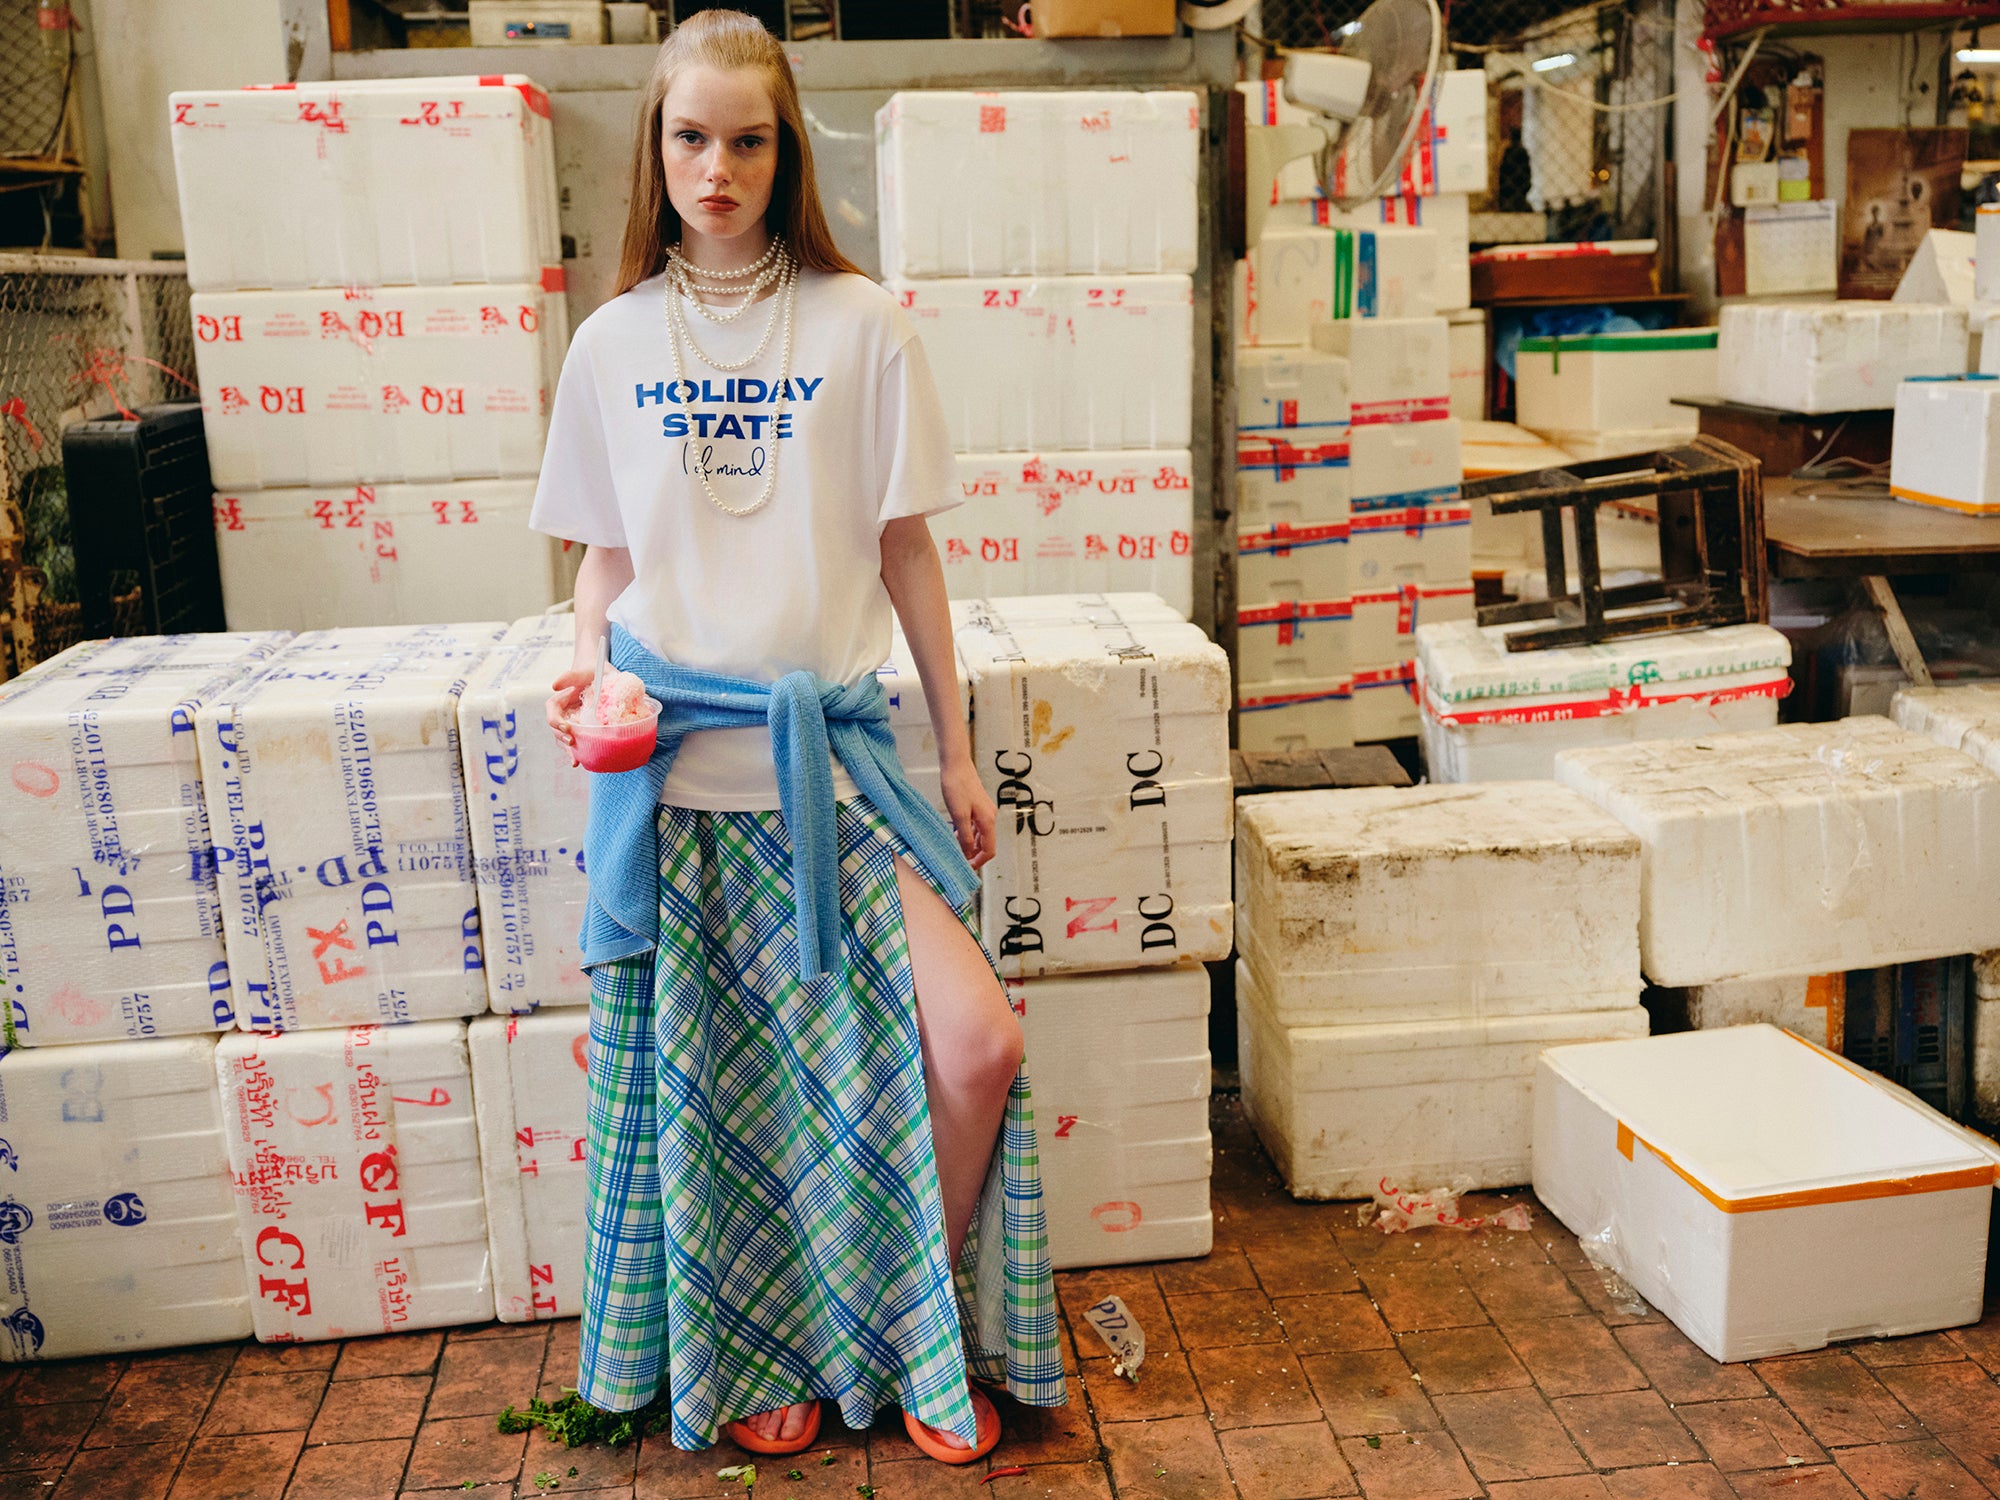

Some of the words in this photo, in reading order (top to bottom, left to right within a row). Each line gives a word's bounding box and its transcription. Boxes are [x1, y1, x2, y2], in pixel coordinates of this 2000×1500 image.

[983, 289, 1022, 308] ZJ
[635, 377, 824, 409] HOLIDAY
[662, 413, 793, 440] STATE
[83, 708, 122, 861] TEL:089611075
[1127, 750, 1167, 812] DC
[1138, 893, 1177, 953] DC
